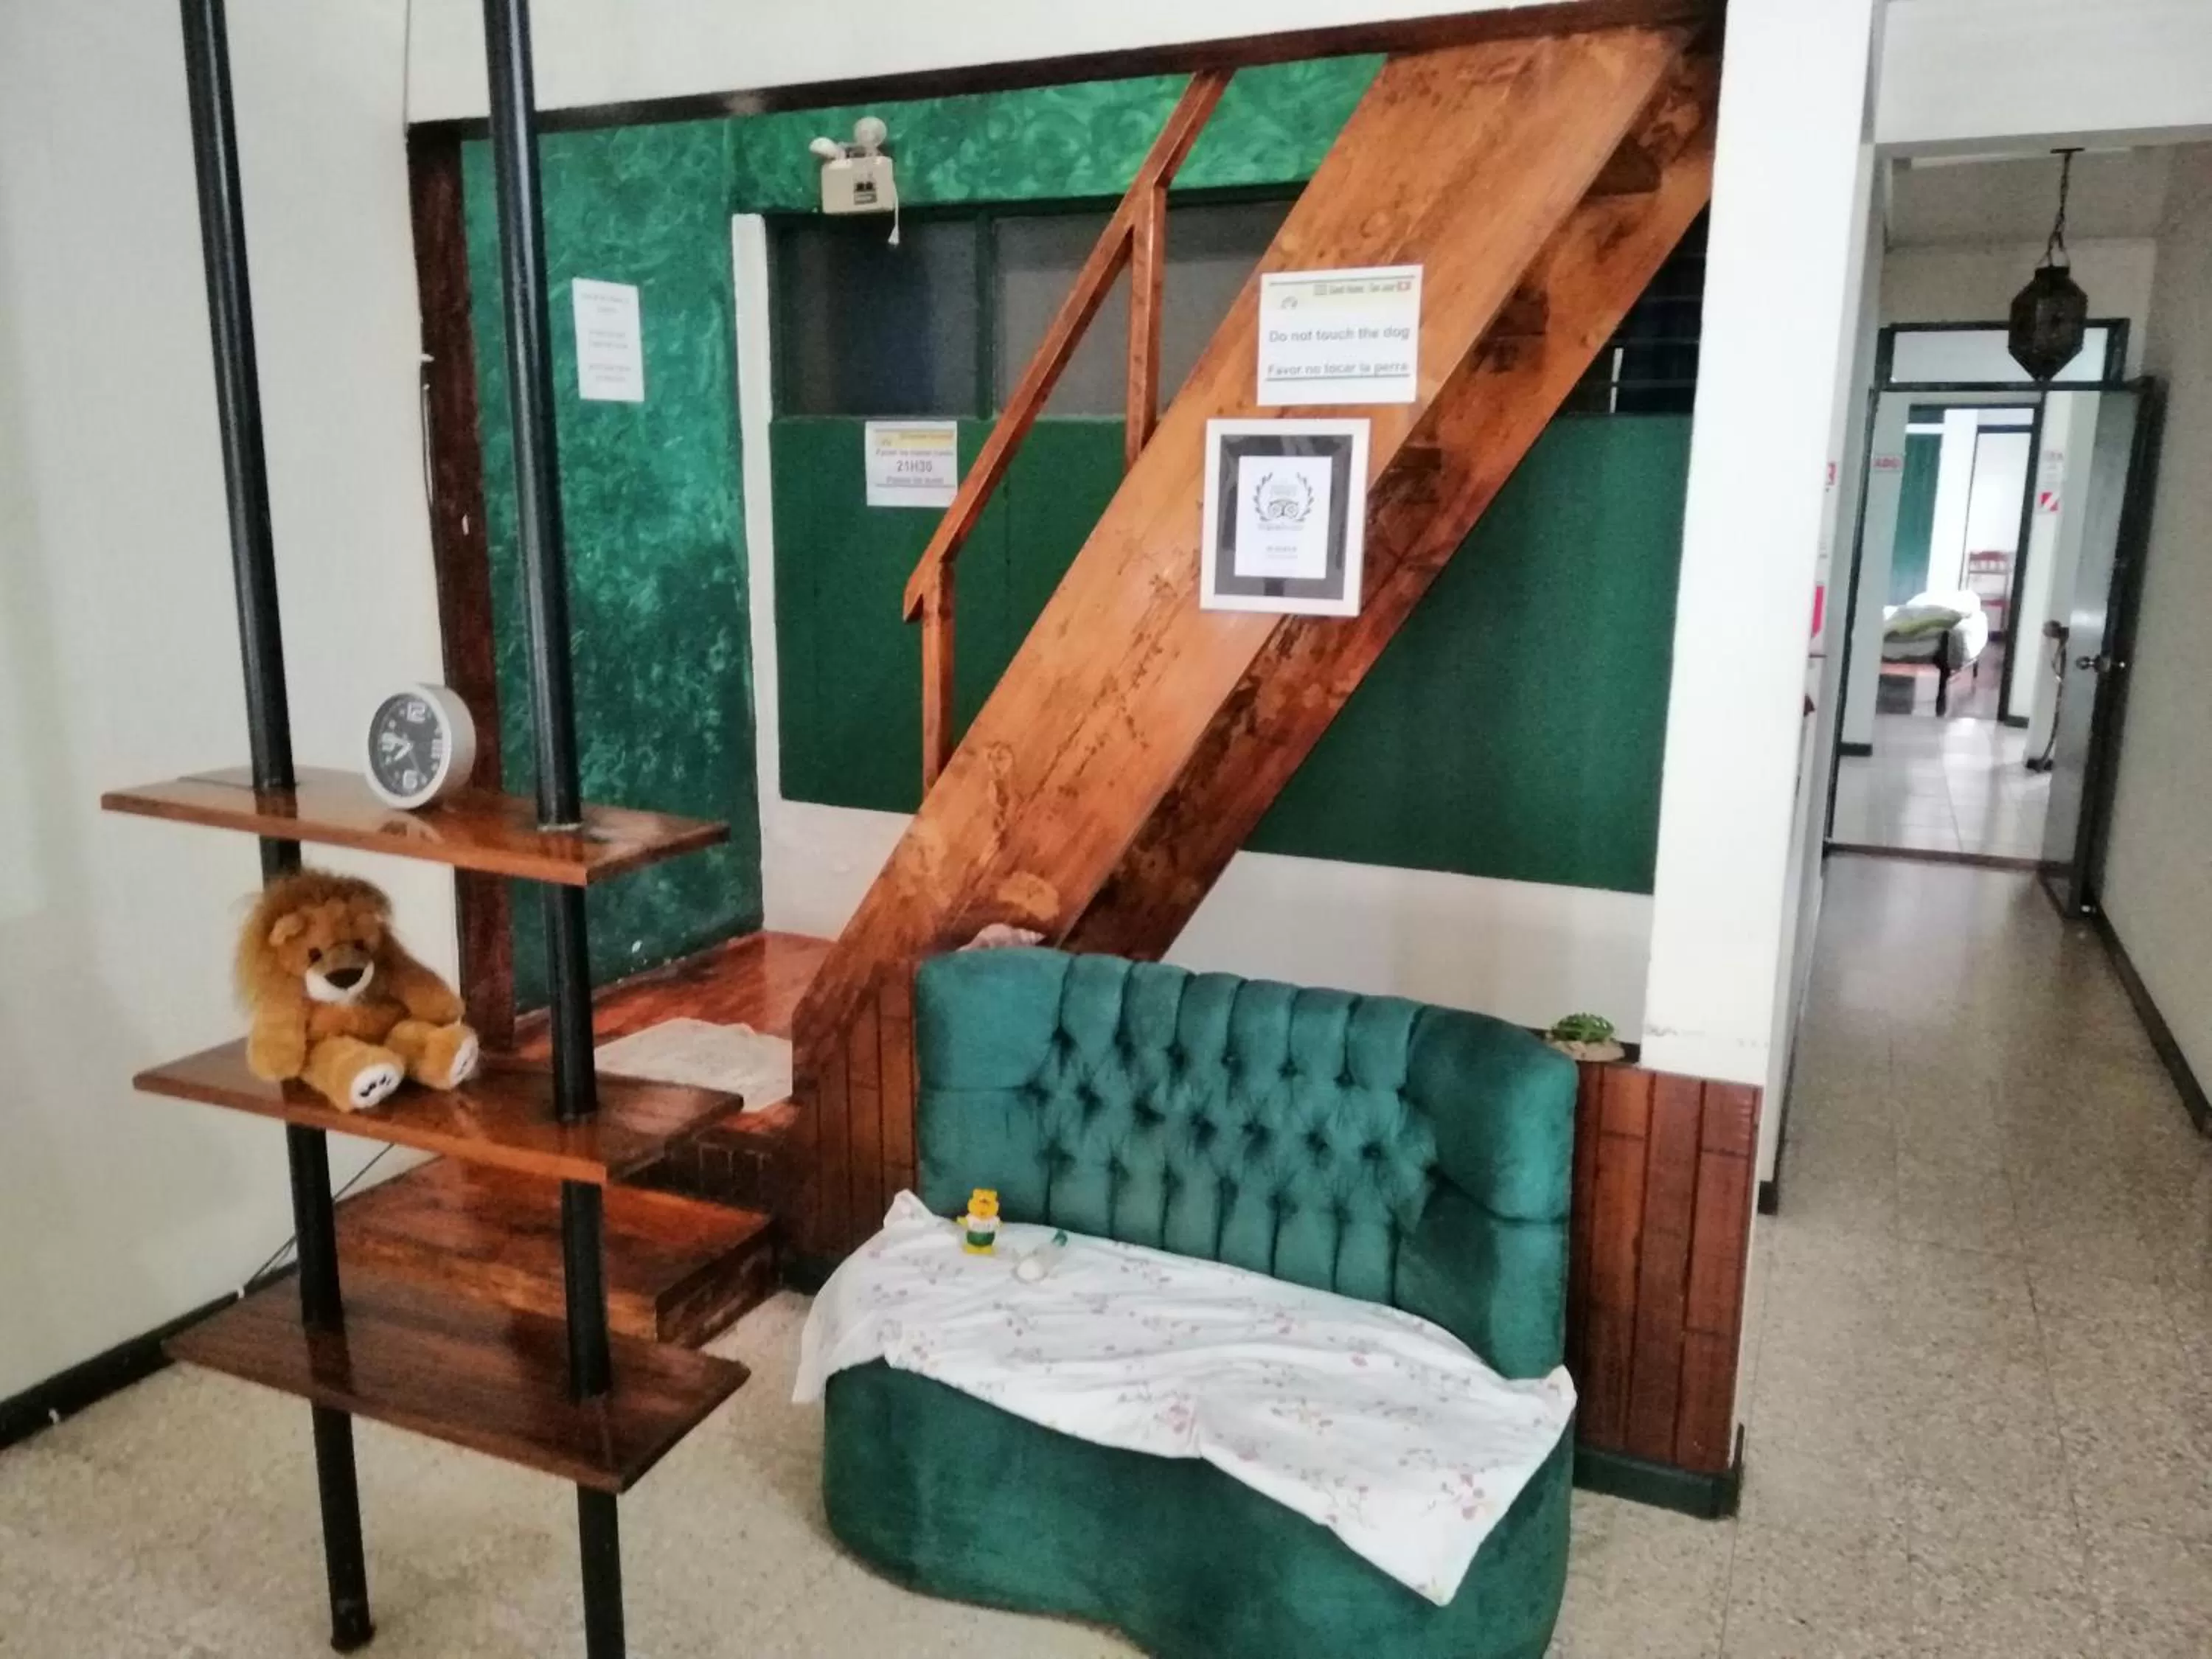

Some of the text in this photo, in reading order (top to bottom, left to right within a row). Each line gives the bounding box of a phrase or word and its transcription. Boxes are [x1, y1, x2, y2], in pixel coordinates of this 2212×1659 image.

[1268, 325, 1410, 342] Do not touch the dog
[1304, 365, 1321, 375] no
[407, 701, 426, 723] 12
